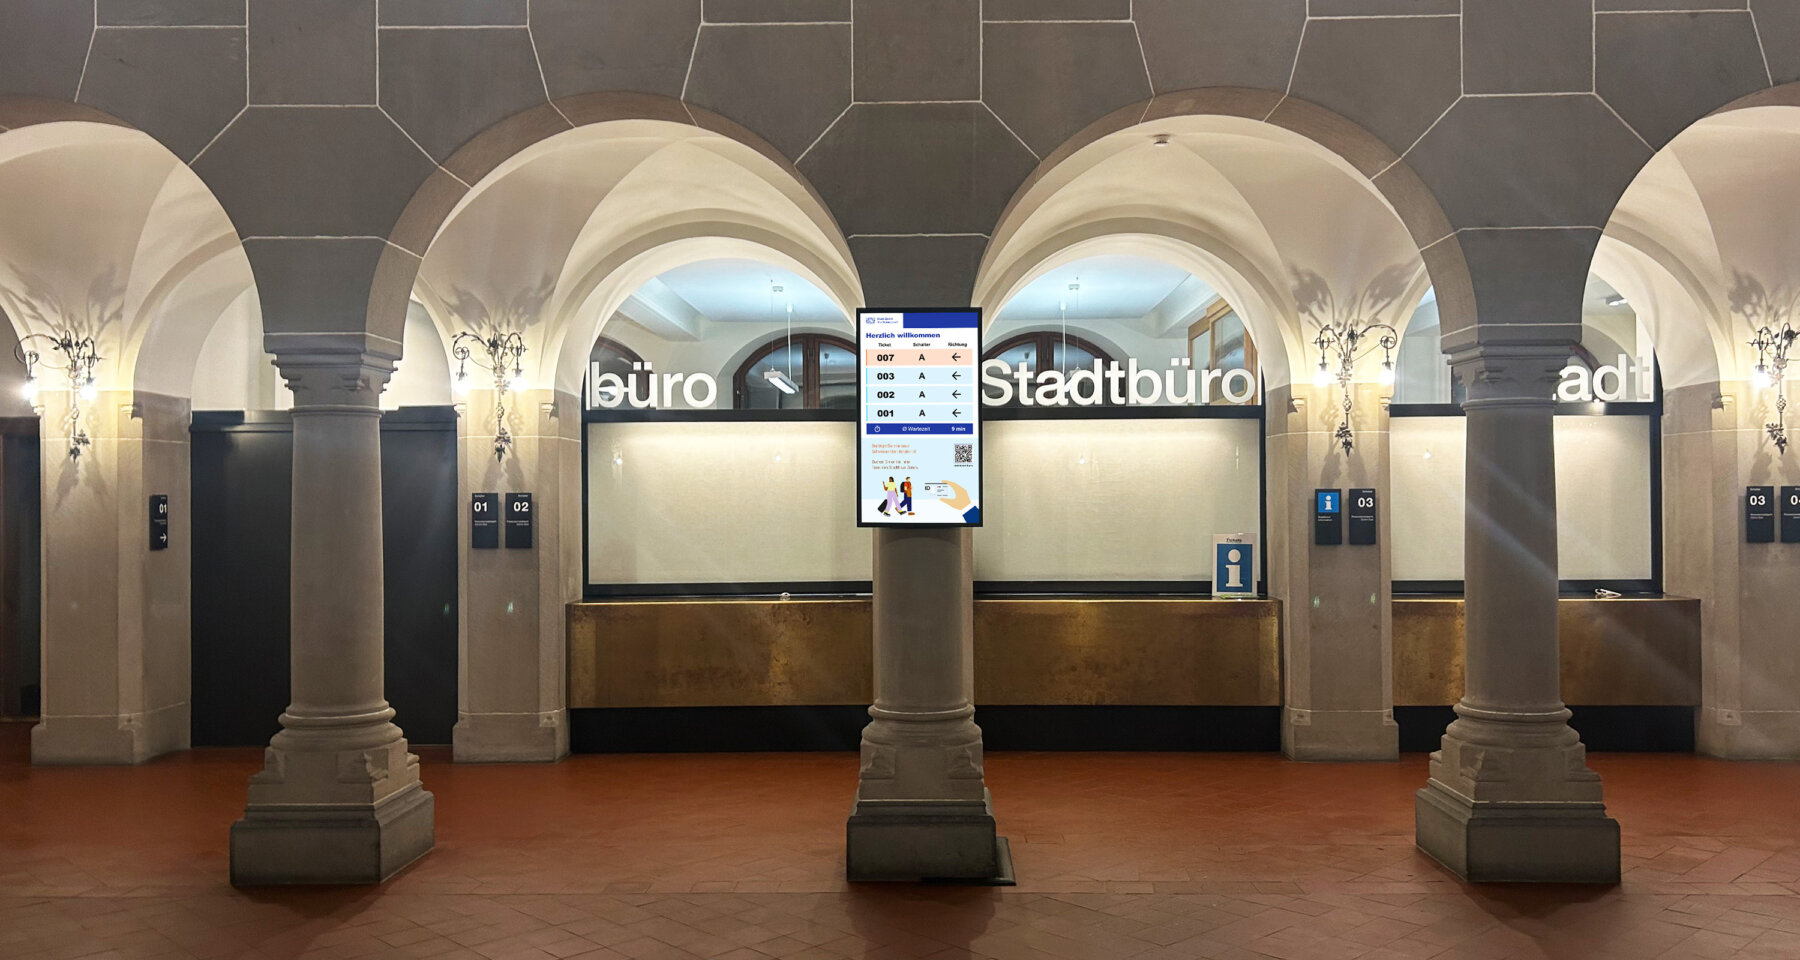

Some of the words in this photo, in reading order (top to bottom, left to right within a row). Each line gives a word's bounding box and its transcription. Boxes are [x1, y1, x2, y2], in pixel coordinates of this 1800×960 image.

[591, 361, 717, 408] büro
[981, 358, 1256, 406] Stadtbüro
[1358, 498, 1374, 508] 03
[1750, 495, 1766, 506] 03
[1790, 495, 1800, 506] 0
[159, 504, 166, 514] 01
[474, 502, 488, 512] 01
[514, 502, 528, 512] 02
